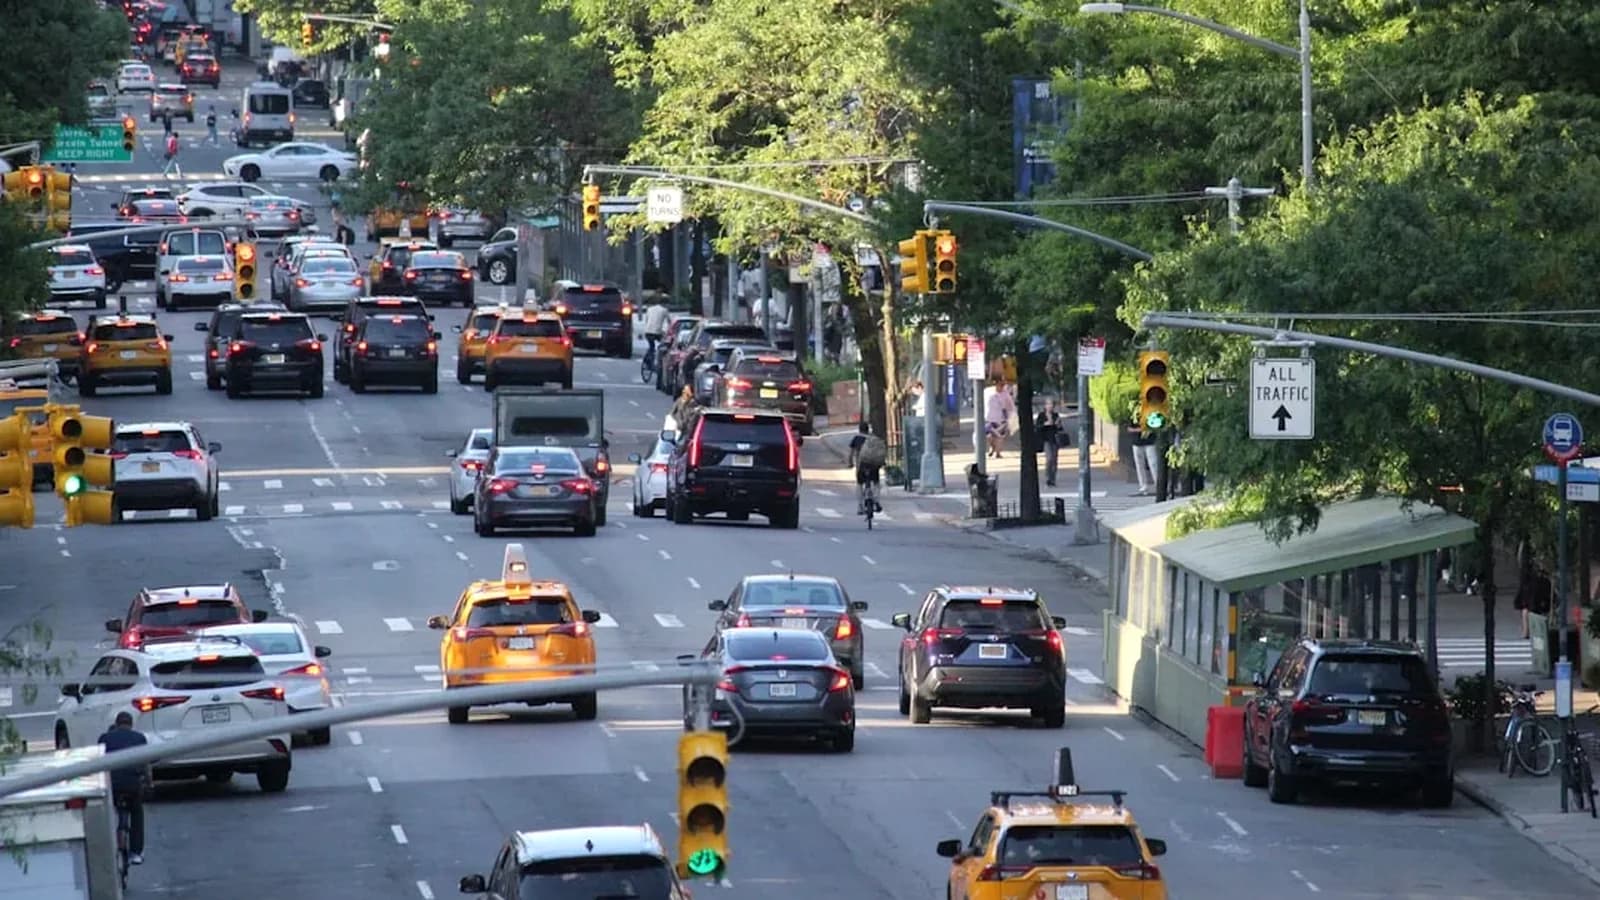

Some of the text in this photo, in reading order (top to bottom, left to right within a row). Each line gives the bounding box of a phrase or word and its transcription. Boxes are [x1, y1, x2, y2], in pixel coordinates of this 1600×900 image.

[57, 150, 115, 159] KEEP RIGHT
[657, 193, 672, 203] NO
[650, 207, 681, 216] TURNS
[1268, 367, 1296, 381] ALL
[1256, 386, 1309, 401] TRAFFIC
